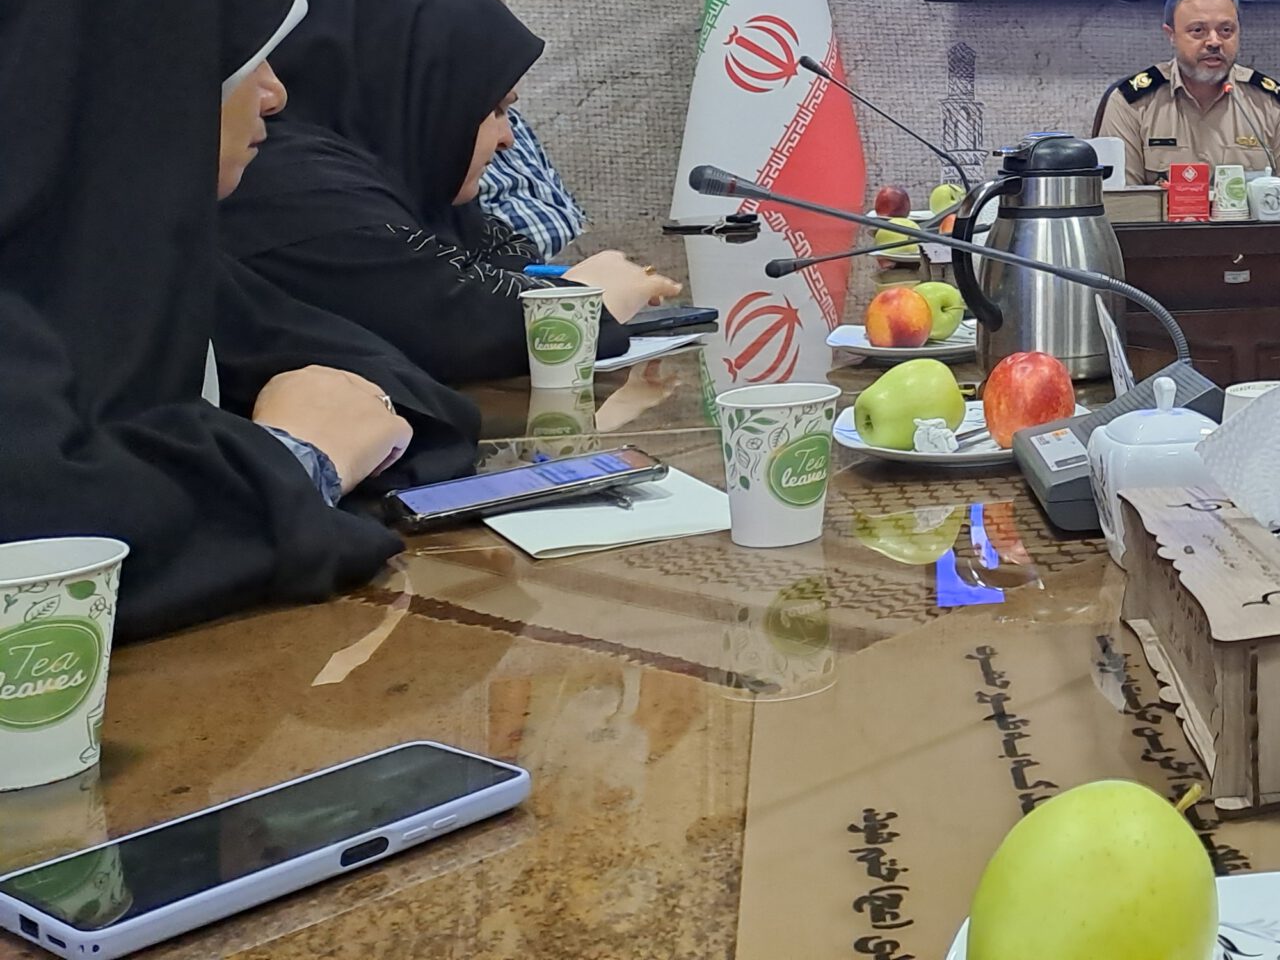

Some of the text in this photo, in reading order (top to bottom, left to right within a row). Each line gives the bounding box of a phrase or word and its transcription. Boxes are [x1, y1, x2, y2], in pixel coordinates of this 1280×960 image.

[534, 337, 574, 351] leaves
[540, 326, 566, 343] Tea
[794, 447, 826, 474] Tea
[781, 467, 828, 489] leaves
[8, 640, 80, 679] Tea
[964, 645, 1011, 690] حضرت
[975, 691, 1031, 731] ظهور
[998, 731, 1033, 760] به
[848, 847, 910, 883] ختم
